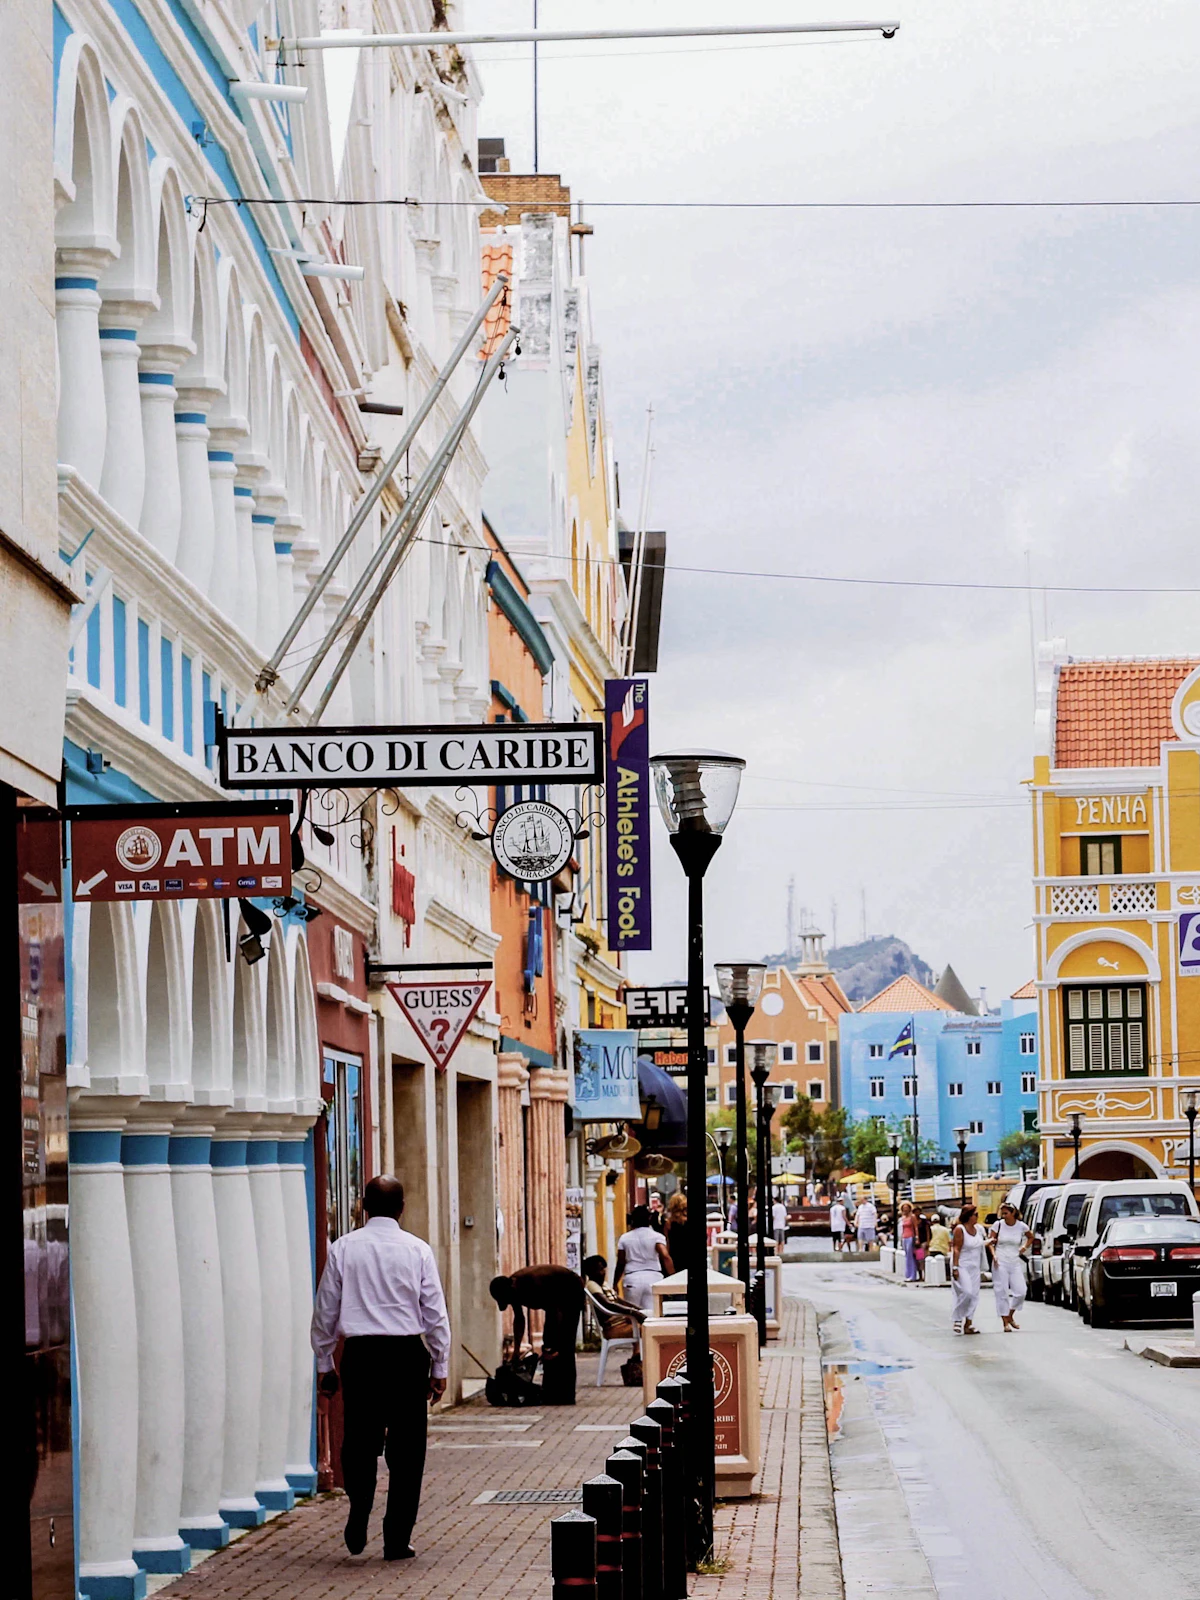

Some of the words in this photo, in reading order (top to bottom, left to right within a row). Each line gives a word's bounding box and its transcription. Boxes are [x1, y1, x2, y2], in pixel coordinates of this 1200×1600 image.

[634, 683, 646, 703] The
[234, 741, 375, 774] BANCO
[386, 741, 428, 771] DI
[439, 738, 590, 771] CARIBE
[514, 806, 524, 815] DI
[527, 804, 558, 819] CARIBE
[616, 766, 640, 877] Athlete's
[1075, 796, 1147, 825] PENHA
[163, 826, 280, 867] ATM
[618, 886, 641, 940] Foot
[404, 989, 473, 1009] GUESS
[628, 1018, 709, 1026] JEWELES
